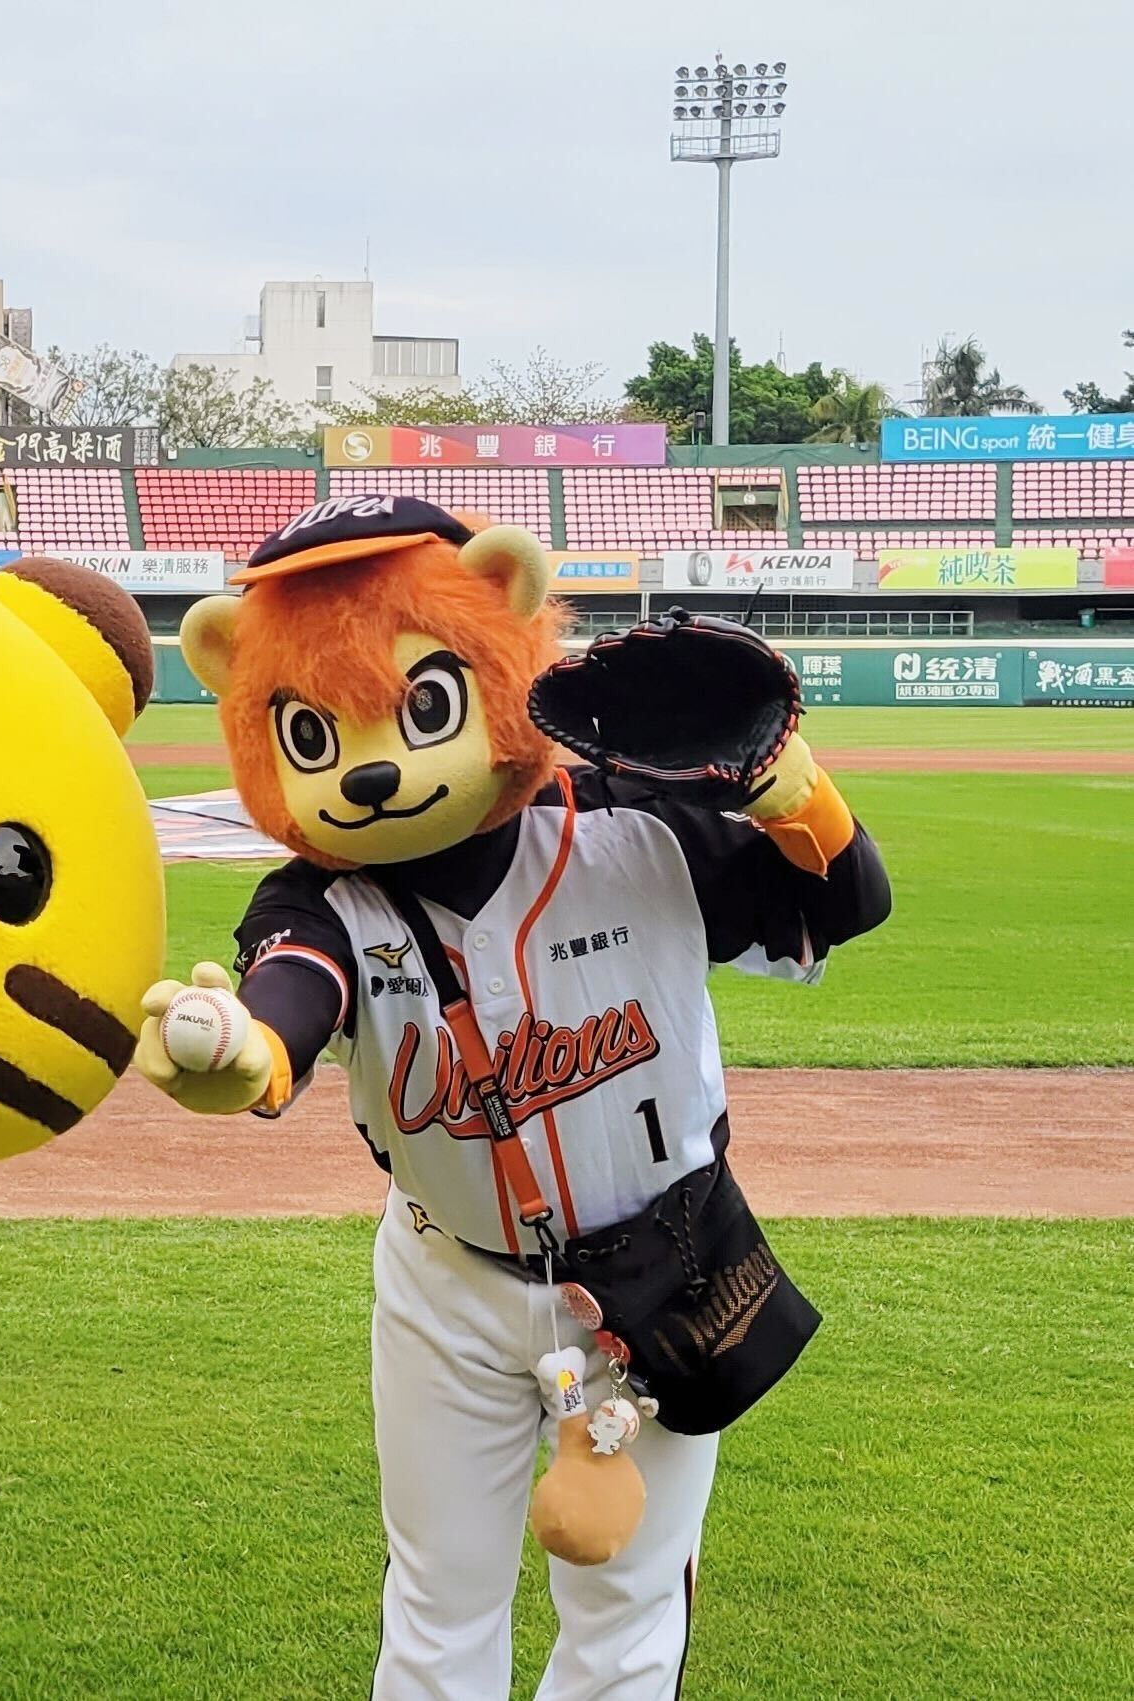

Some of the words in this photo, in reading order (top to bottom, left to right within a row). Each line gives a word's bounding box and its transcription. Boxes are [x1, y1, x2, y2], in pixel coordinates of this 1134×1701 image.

[419, 434, 616, 458] 兆豐銀行
[903, 427, 978, 450] BEING
[981, 436, 1019, 453] sport
[760, 556, 832, 570] KENDA
[939, 552, 1016, 586] 純喫茶
[802, 655, 842, 675] 輝葉
[549, 926, 629, 962] 兆豐銀行
[389, 999, 660, 1139] Unilions
[491, 1094, 512, 1136] UNILIONS
[634, 1097, 669, 1163] 1
